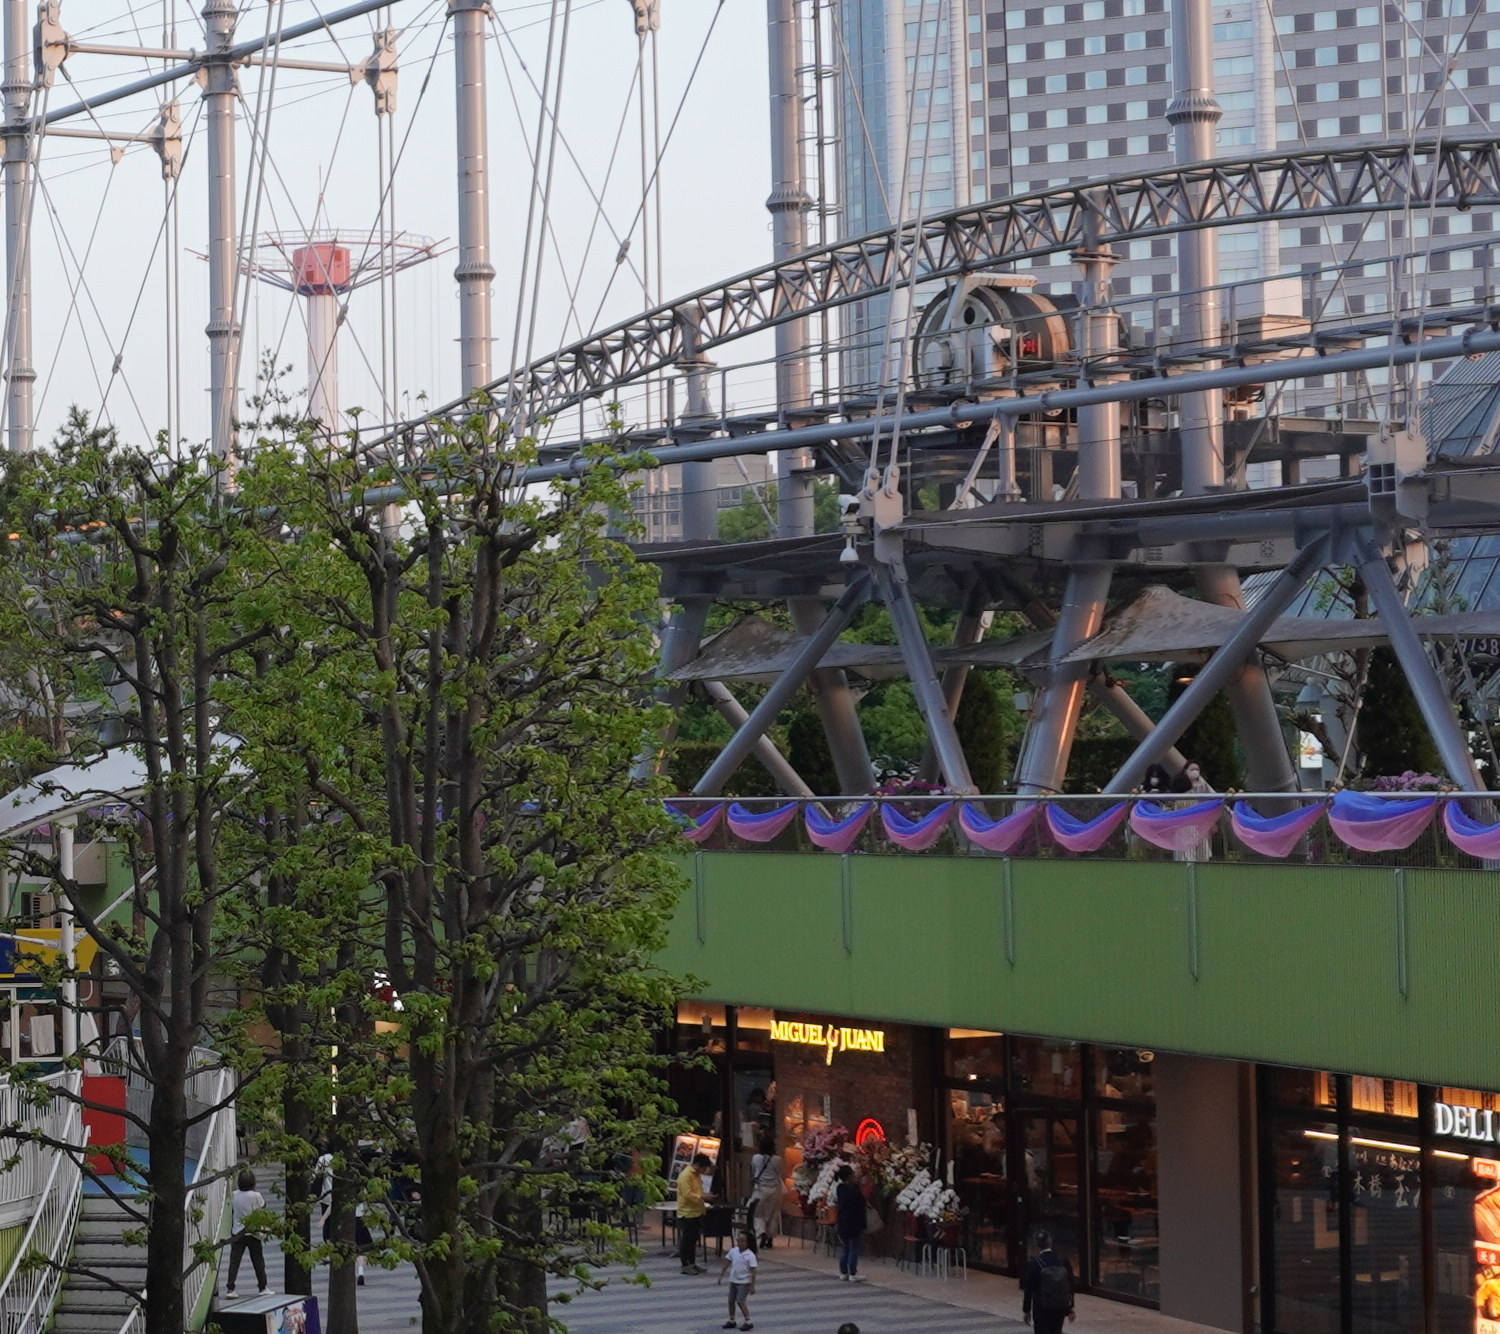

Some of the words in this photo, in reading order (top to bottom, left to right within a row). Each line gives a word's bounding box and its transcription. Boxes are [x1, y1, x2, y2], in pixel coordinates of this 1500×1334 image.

[770, 1020, 826, 1045] MIGUEL
[840, 1027, 885, 1052] JUANI
[1435, 1102, 1494, 1142] DELI
